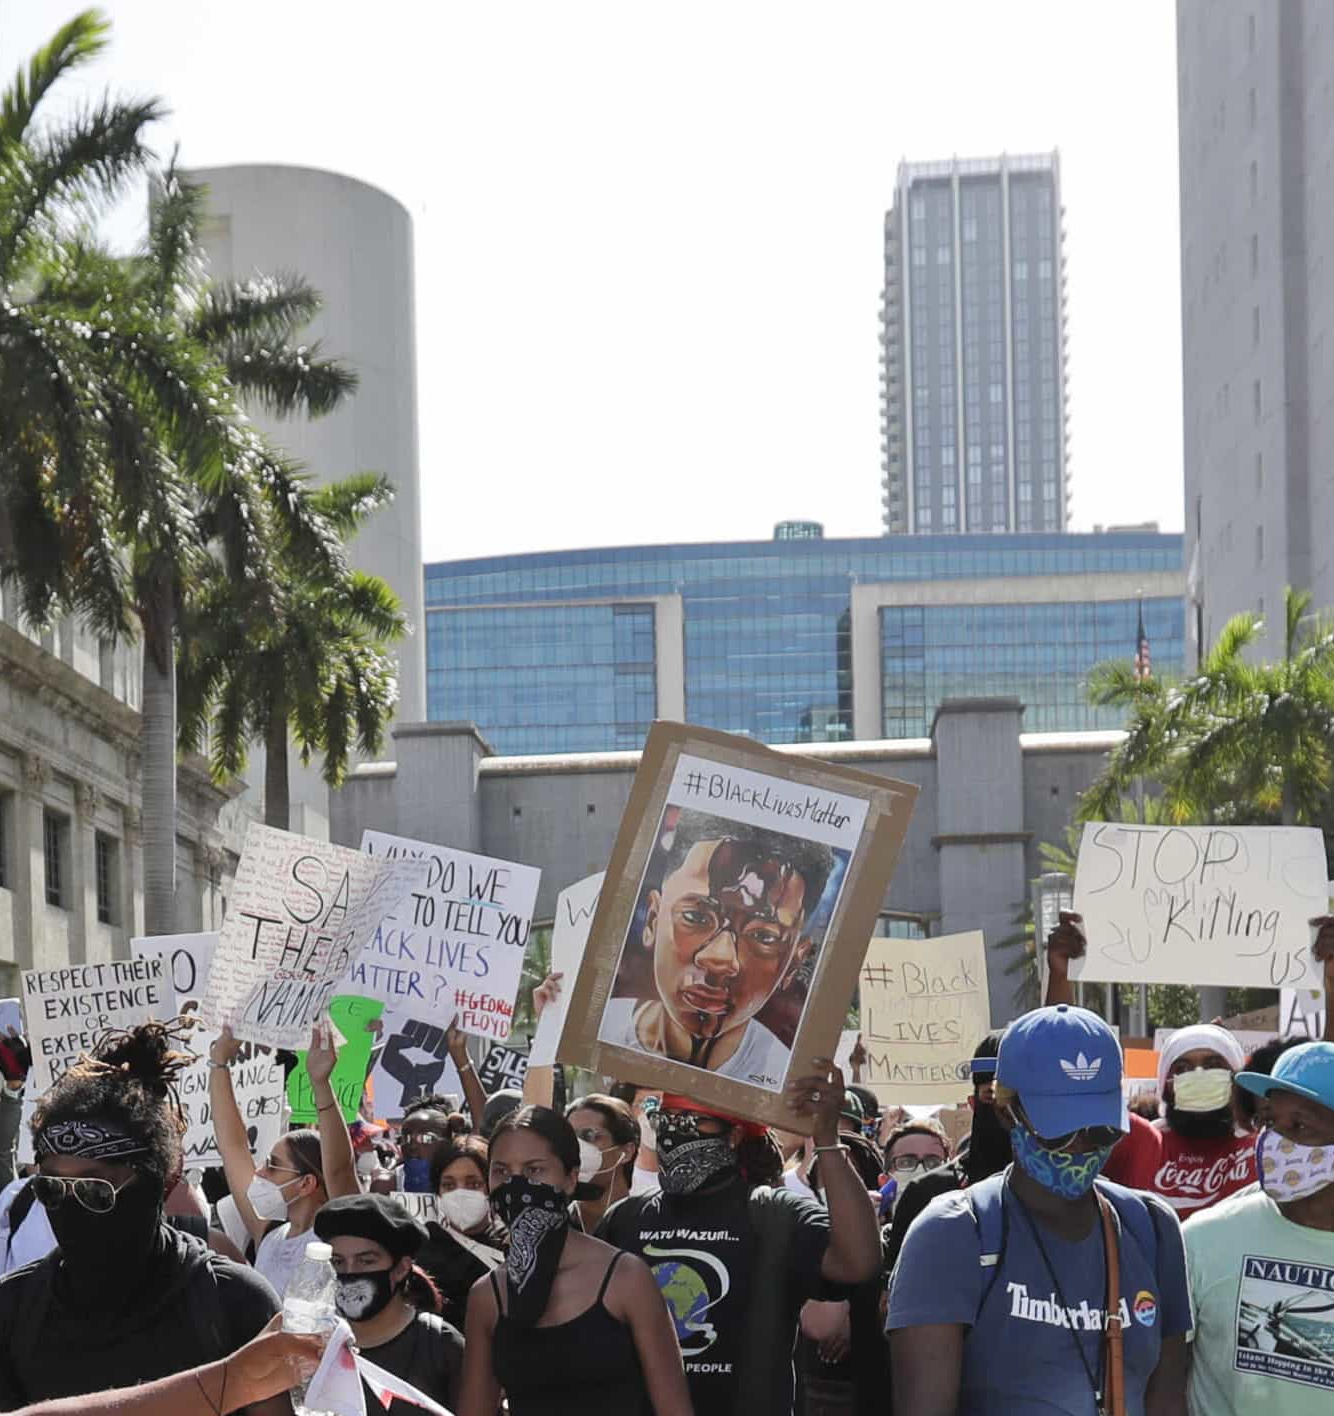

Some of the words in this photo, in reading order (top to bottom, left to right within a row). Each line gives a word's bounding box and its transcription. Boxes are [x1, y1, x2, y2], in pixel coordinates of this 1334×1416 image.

[1089, 825, 1239, 895] STOP
[427, 855, 455, 894] DO
[468, 864, 511, 905] WE
[411, 893, 435, 928] TO
[443, 900, 491, 937] TELL
[496, 911, 531, 947] YOU
[365, 926, 416, 961] ACK
[425, 936, 491, 977] LIVES
[25, 963, 105, 995] RESPECT
[110, 959, 164, 985] THEIR
[44, 985, 160, 1020] EXISTENCE
[243, 980, 334, 1028] NAMS
[85, 1014, 113, 1031] OR
[462, 1011, 510, 1038] FLOYD
[867, 1007, 961, 1041] LIVES
[685, 1363, 733, 1373] PEOPLE
